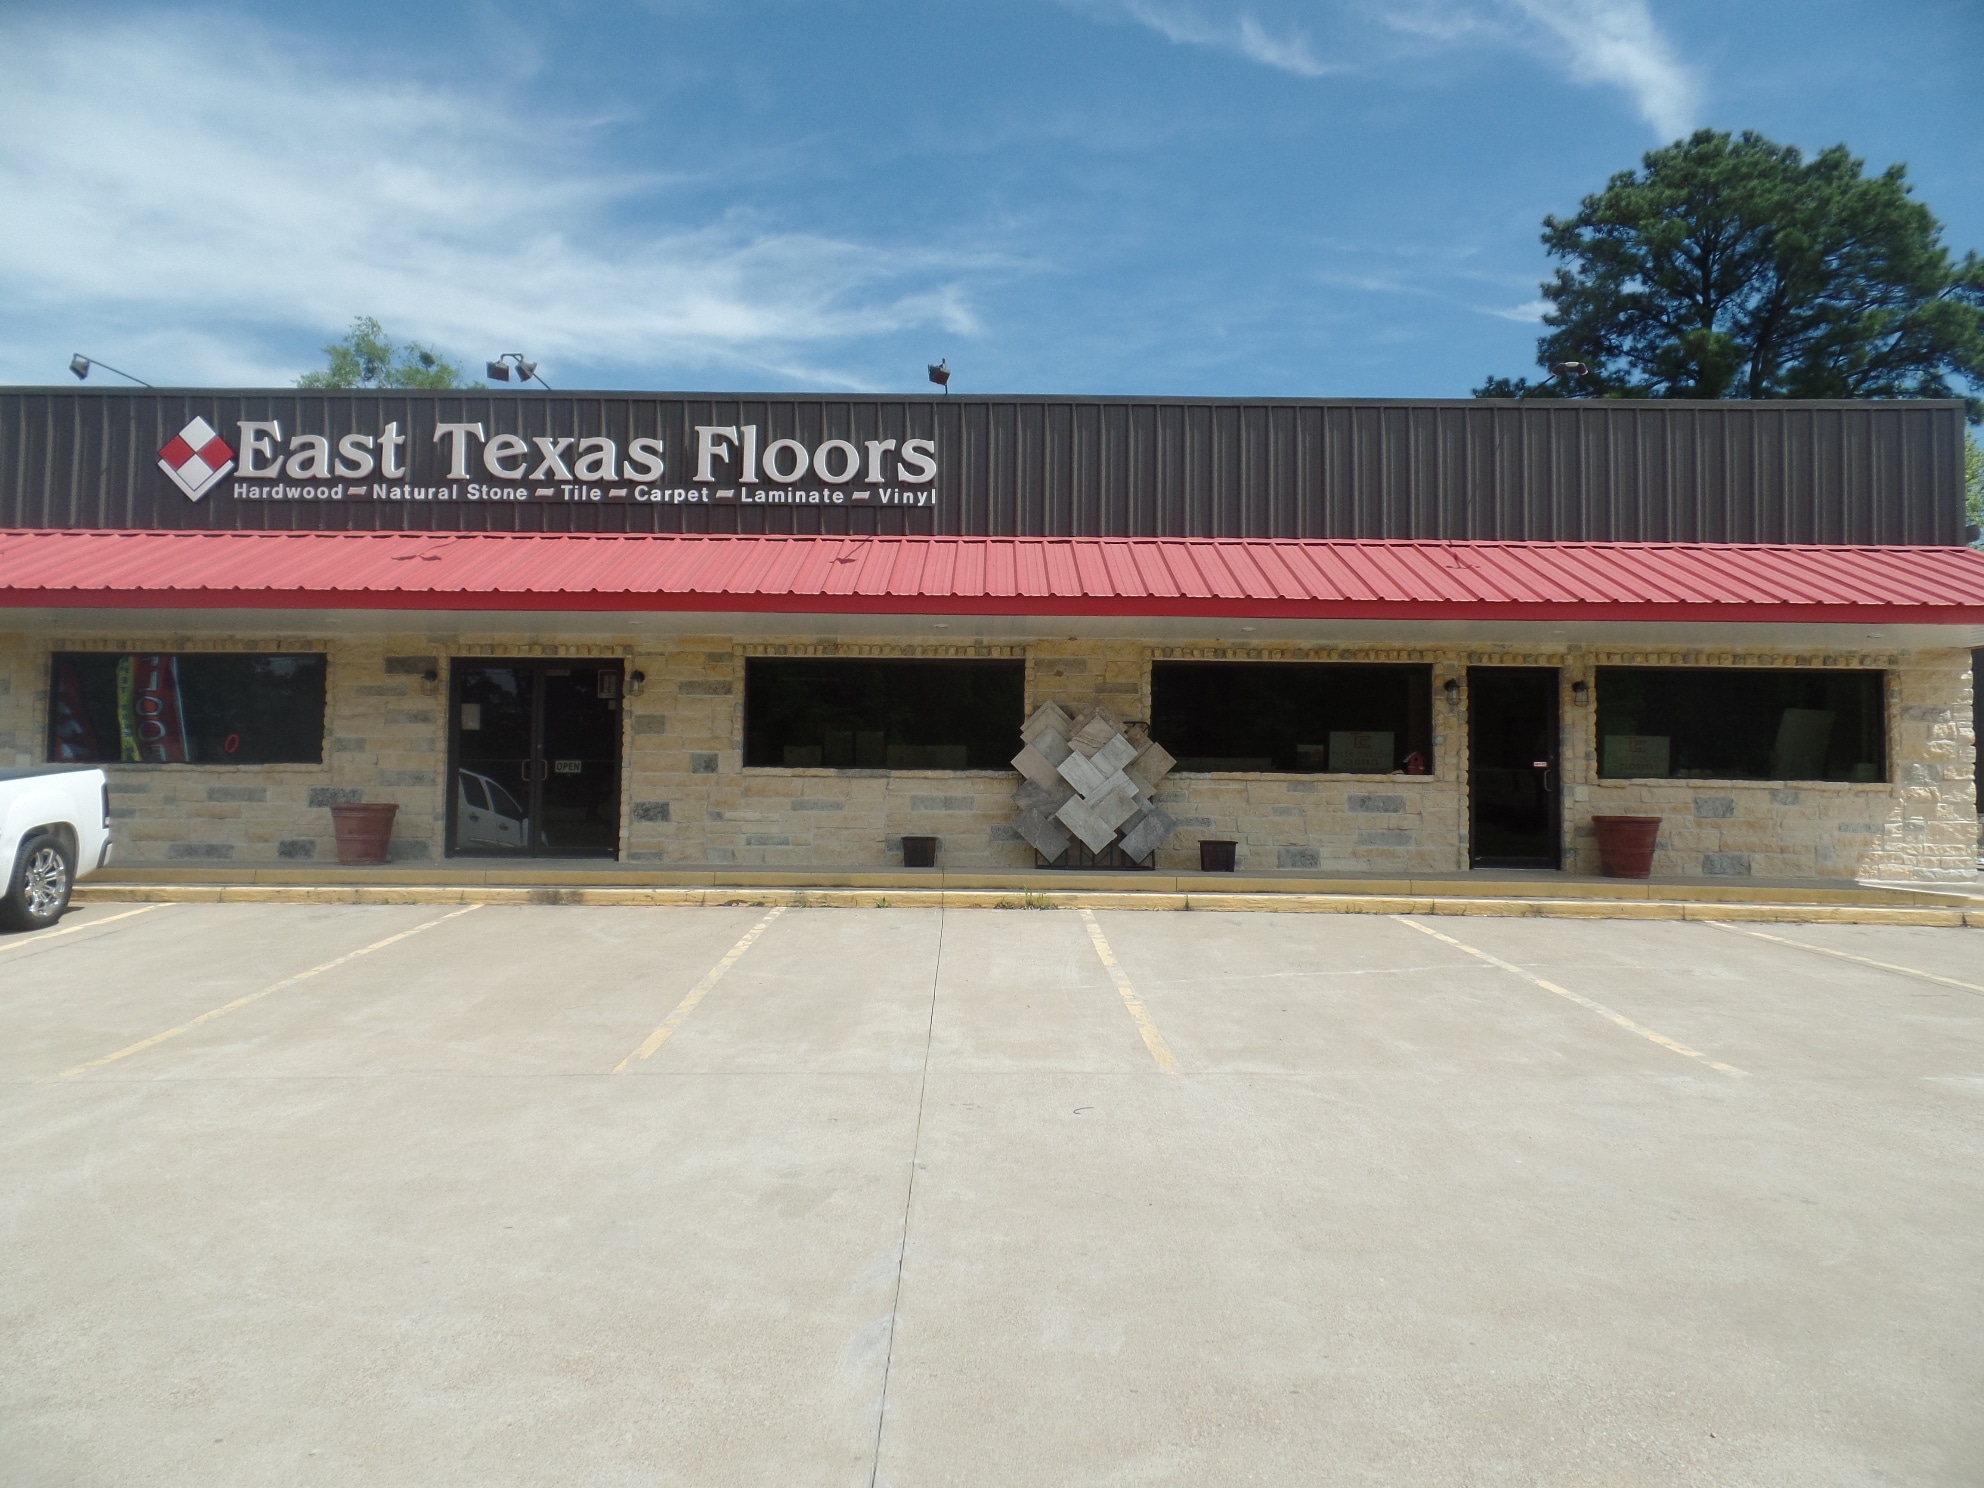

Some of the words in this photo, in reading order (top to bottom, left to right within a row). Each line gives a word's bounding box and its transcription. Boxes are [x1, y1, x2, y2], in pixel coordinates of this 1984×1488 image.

[233, 420, 406, 479] East
[432, 422, 664, 482] Texas
[692, 424, 938, 484] Floors
[233, 483, 343, 500] Hardwood
[372, 483, 457, 500] Natural
[466, 484, 528, 501] Stone
[560, 485, 602, 501] Tile
[634, 485, 709, 504] Carpet
[741, 486, 844, 504] Laminate
[878, 487, 936, 506] Vinyl
[556, 761, 580, 771] OPEN
